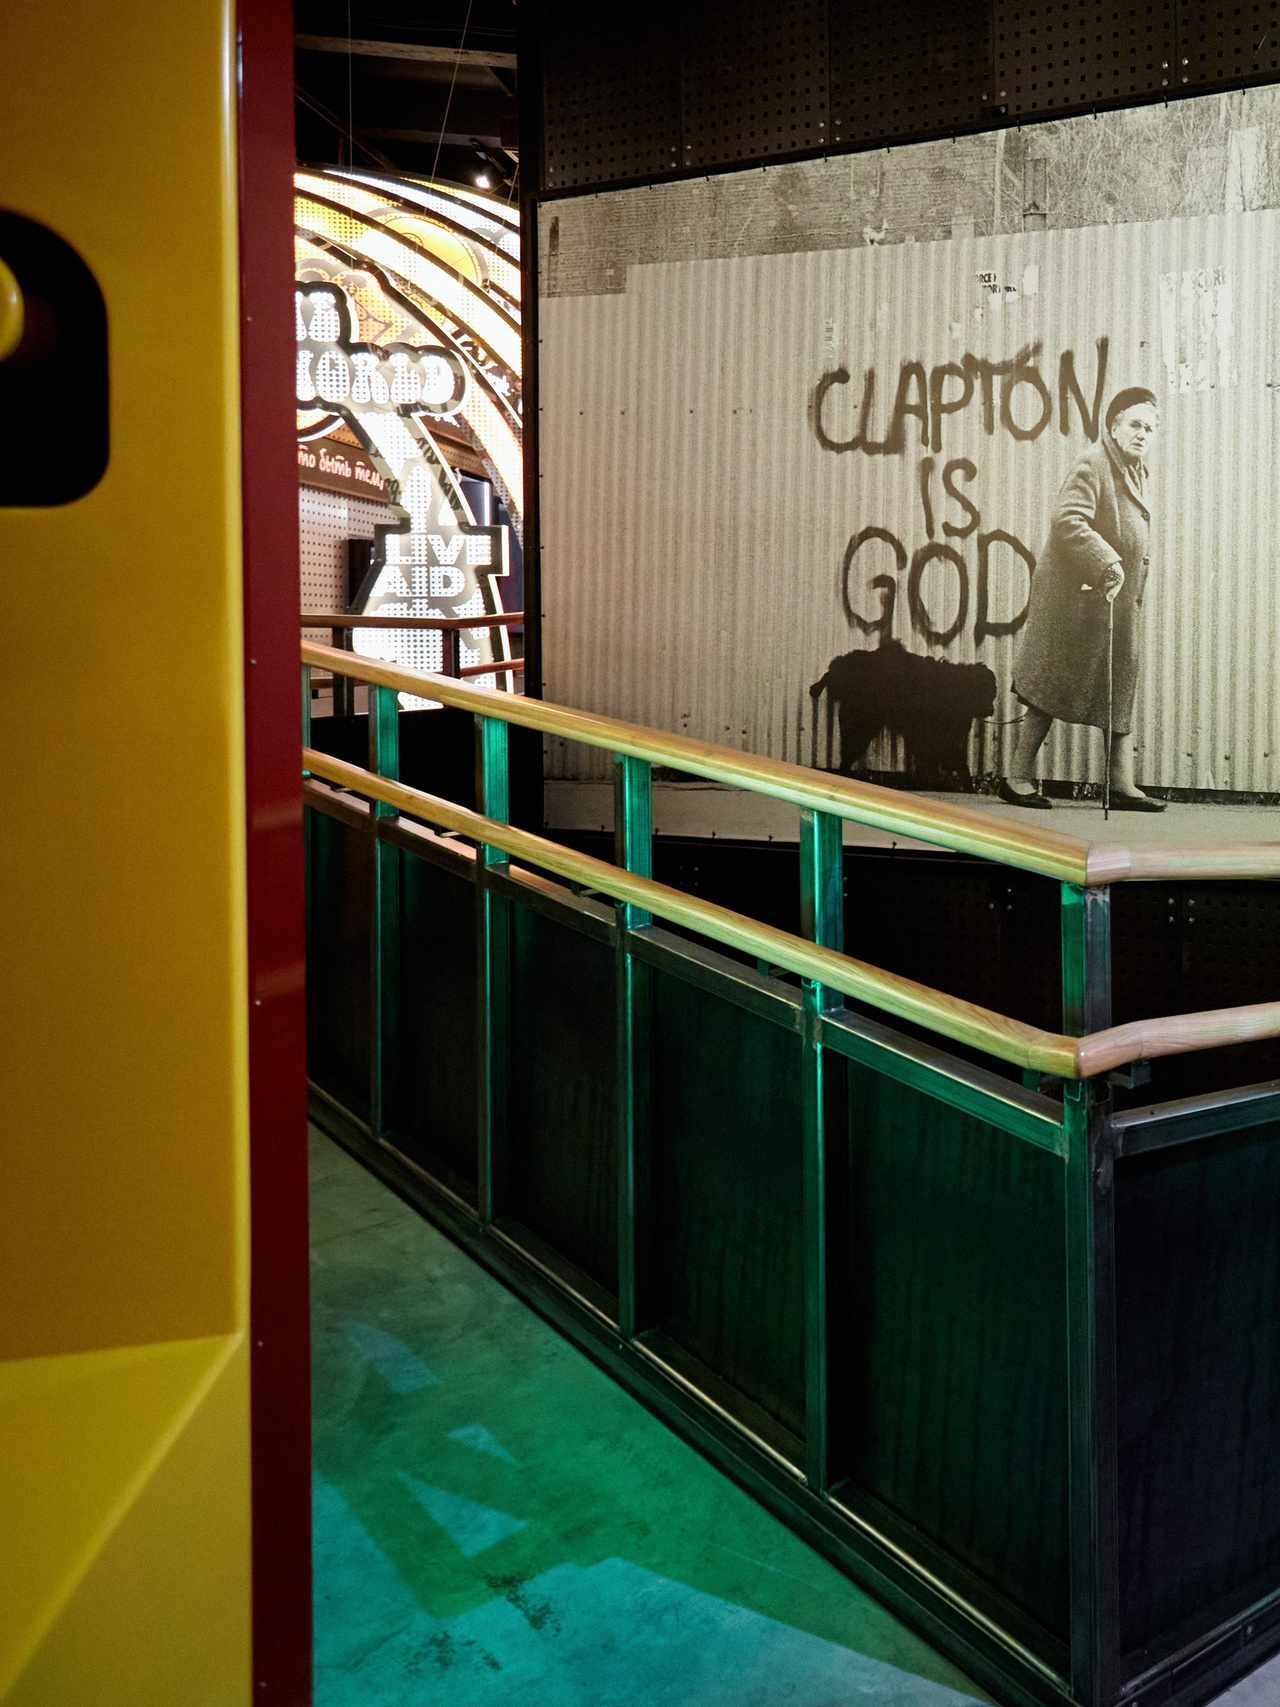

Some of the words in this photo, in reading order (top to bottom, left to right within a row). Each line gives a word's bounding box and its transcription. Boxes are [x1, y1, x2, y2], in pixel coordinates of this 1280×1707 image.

[812, 336, 1109, 455] CLAPTON
[918, 456, 981, 540] IS
[368, 565, 466, 598] AID
[385, 534, 492, 565] LIVE
[842, 526, 1038, 647] GOD
